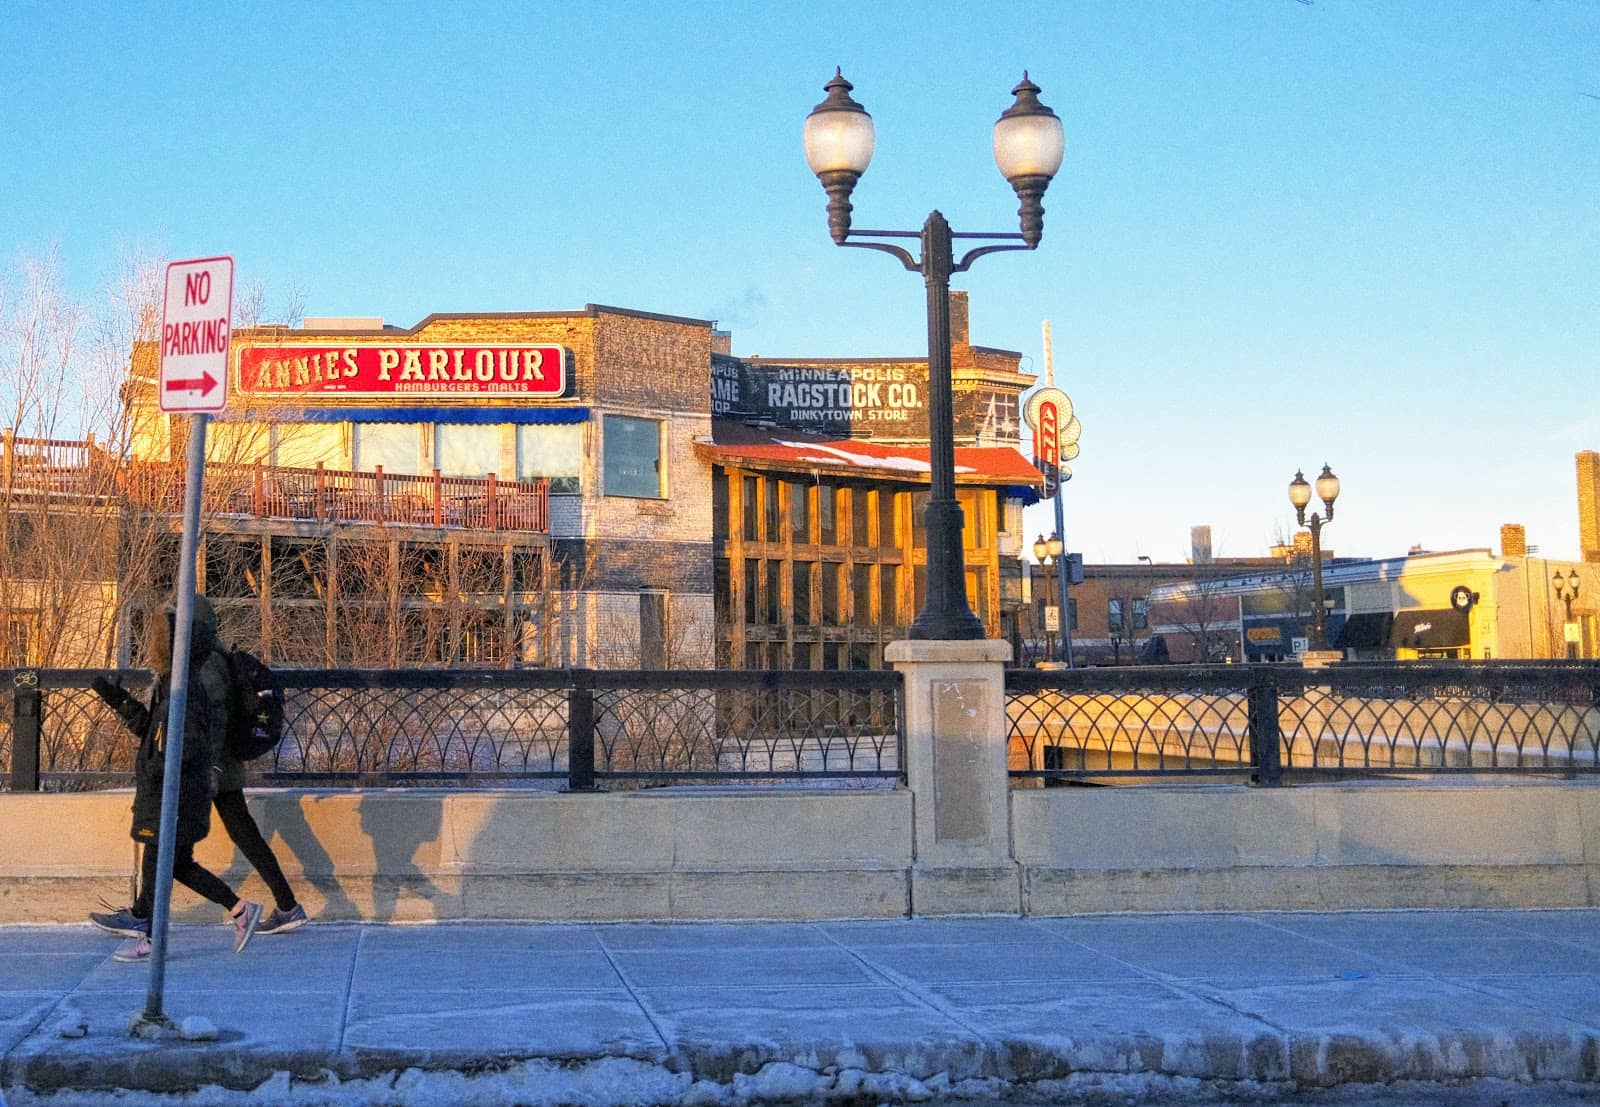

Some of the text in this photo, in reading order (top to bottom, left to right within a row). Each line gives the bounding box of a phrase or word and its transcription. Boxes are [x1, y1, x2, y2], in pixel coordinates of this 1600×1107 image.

[185, 271, 211, 306] NO
[164, 317, 227, 357] PARKING
[257, 348, 545, 388] ANNIES PARLOUR
[779, 368, 905, 382] MINNEAPOLIS
[768, 383, 923, 408] RAGSTOCK CO.
[790, 408, 908, 421] DINKYTOWN STORE
